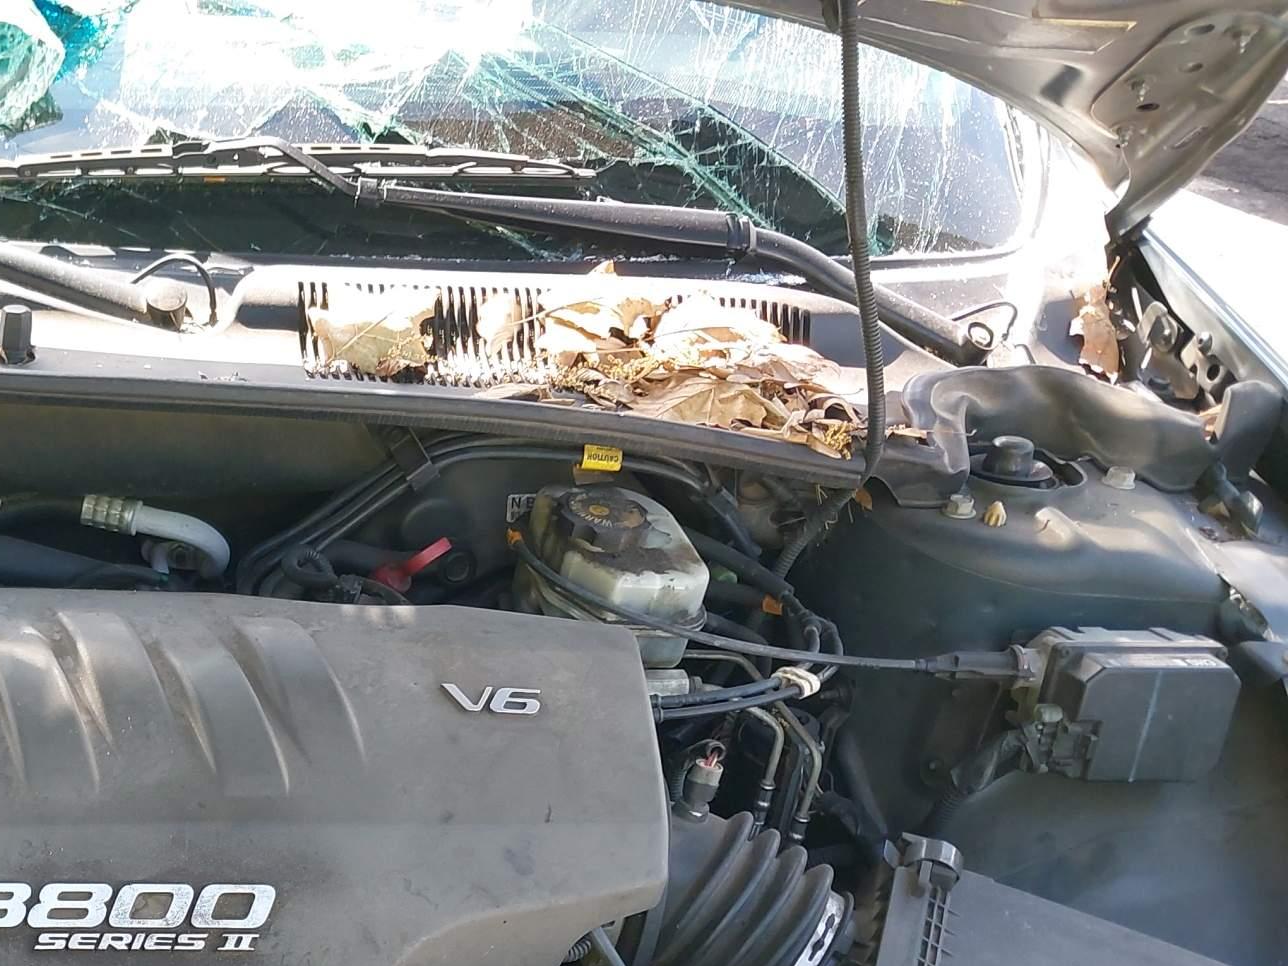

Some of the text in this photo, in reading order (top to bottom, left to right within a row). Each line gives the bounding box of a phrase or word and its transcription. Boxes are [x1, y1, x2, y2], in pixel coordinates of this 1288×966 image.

[440, 683, 541, 714] V6
[33, 932, 260, 951] SERIES II
